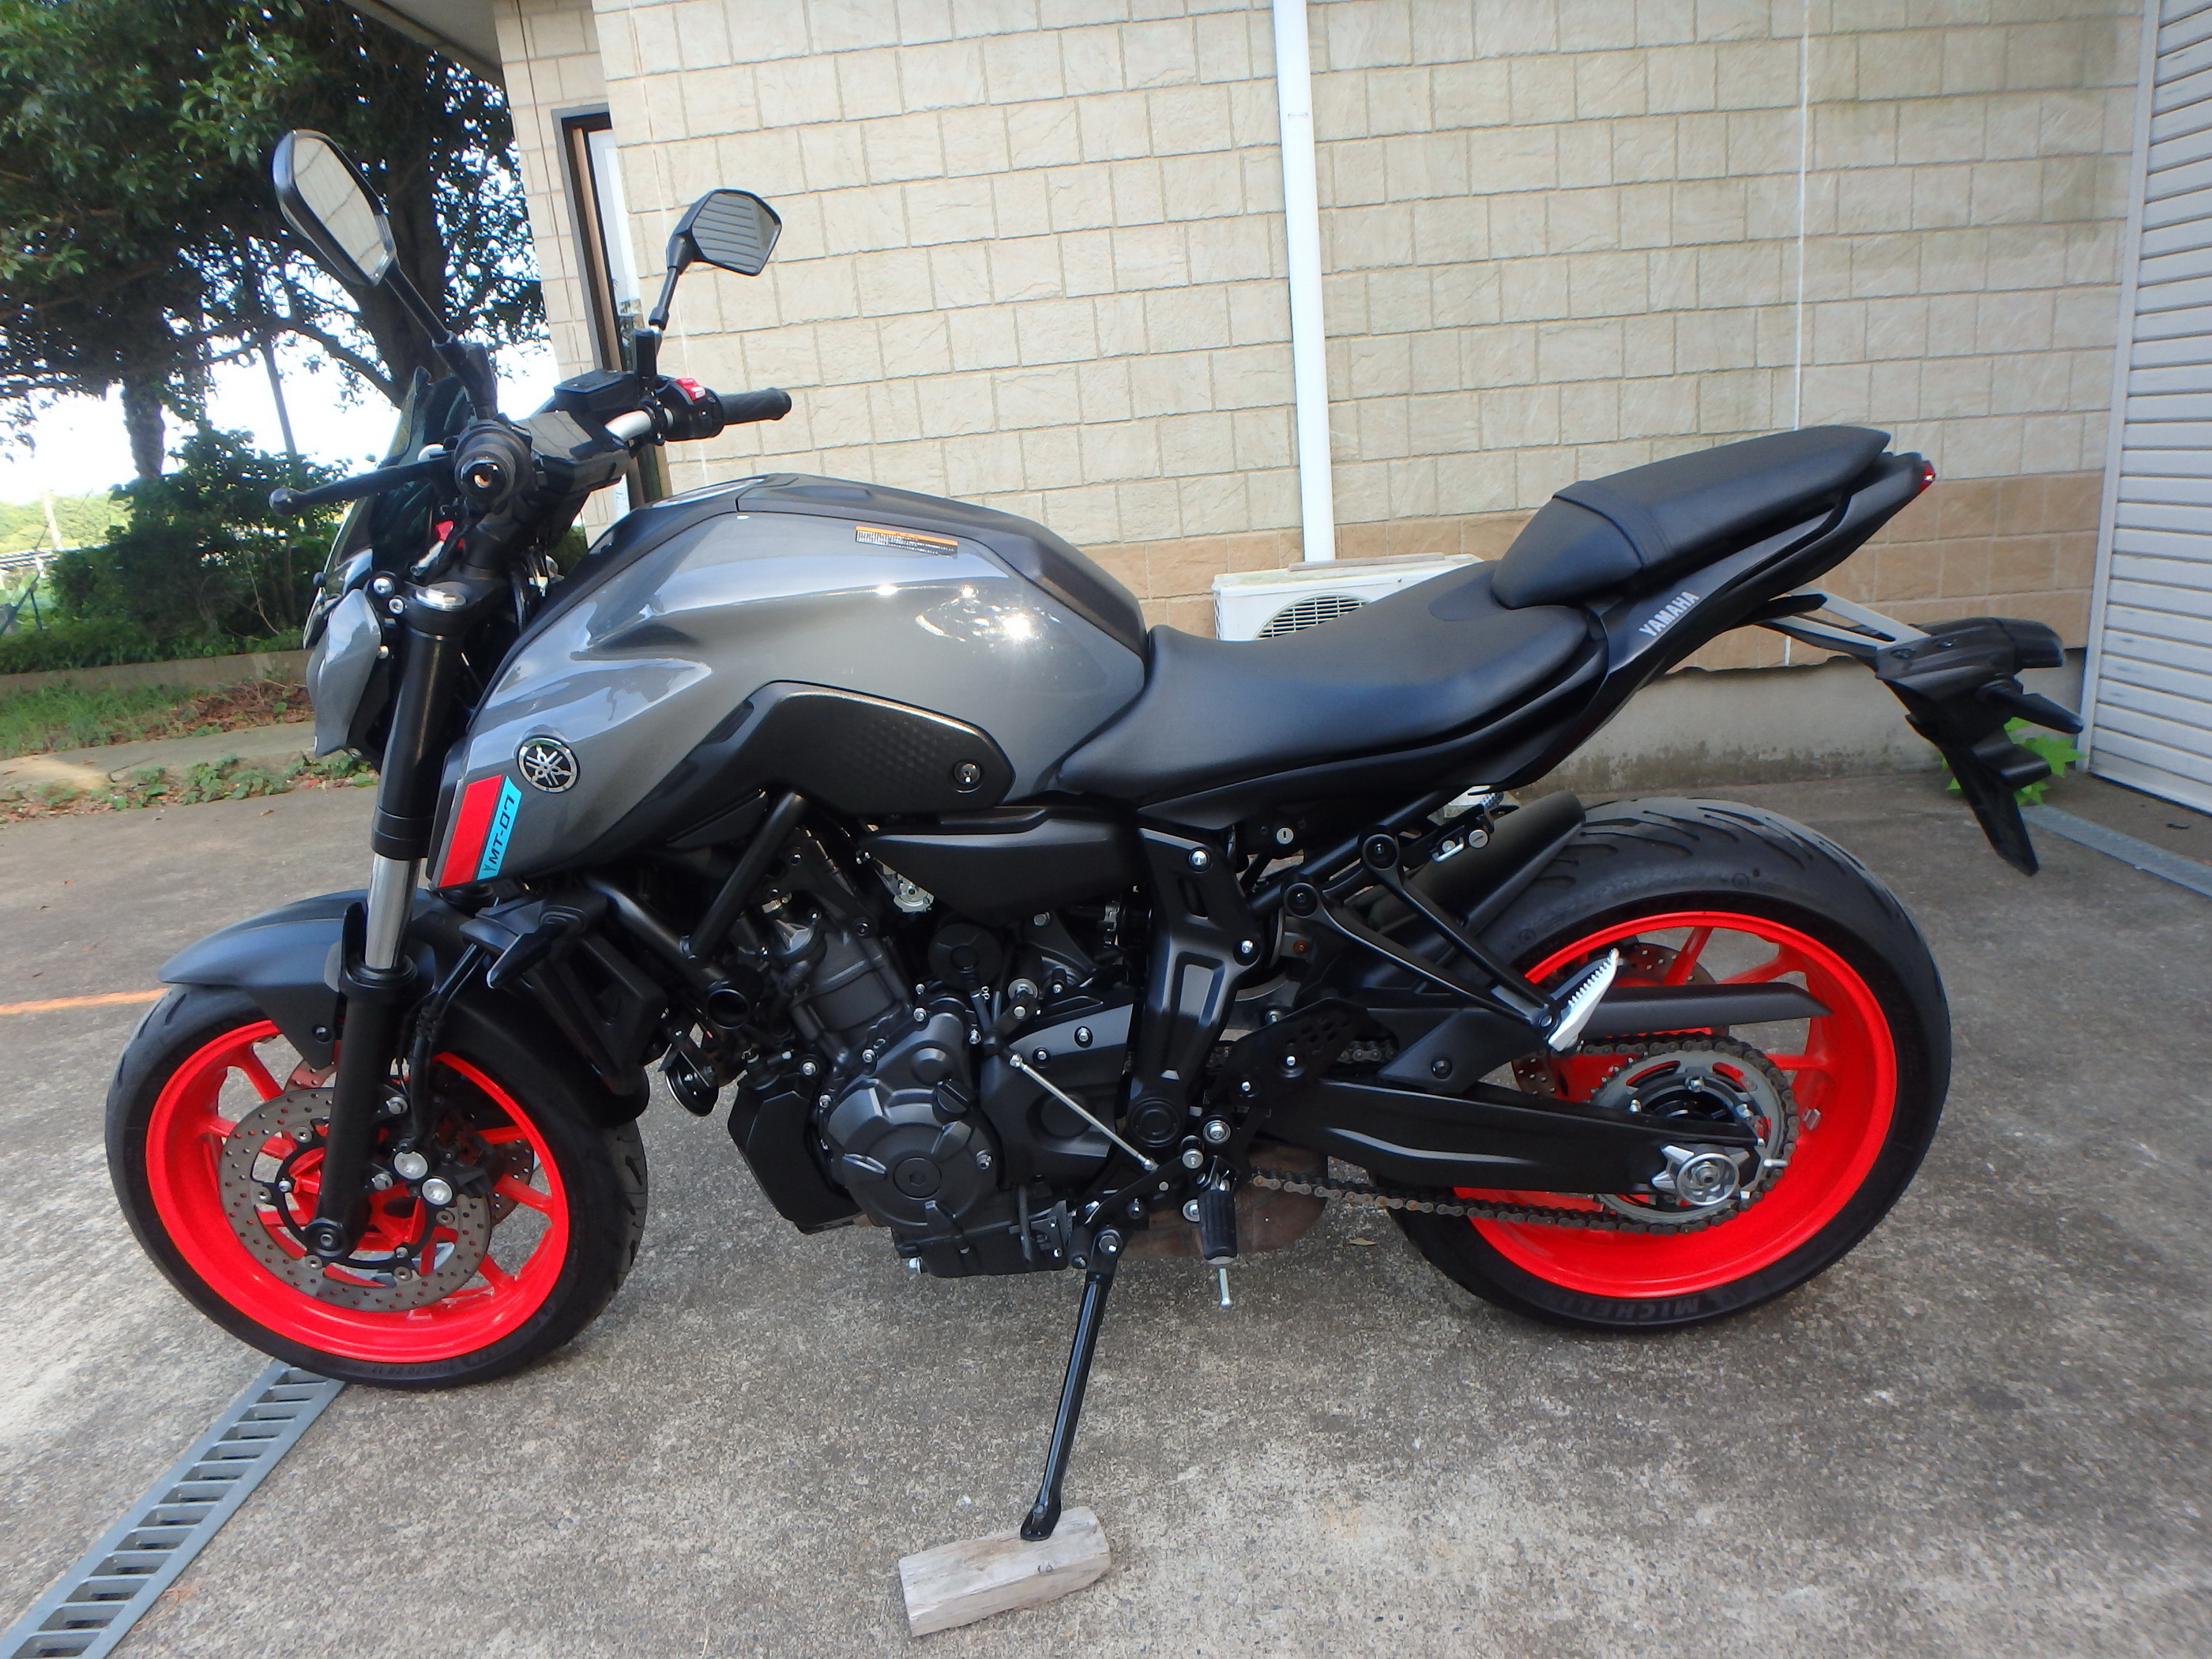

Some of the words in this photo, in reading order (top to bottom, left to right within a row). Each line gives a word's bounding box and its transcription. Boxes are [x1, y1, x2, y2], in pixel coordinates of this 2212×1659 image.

[1638, 591, 1699, 637] YAMAHA
[488, 794, 515, 864] MT-07
[1540, 1290, 1699, 1319] MICHELIN
